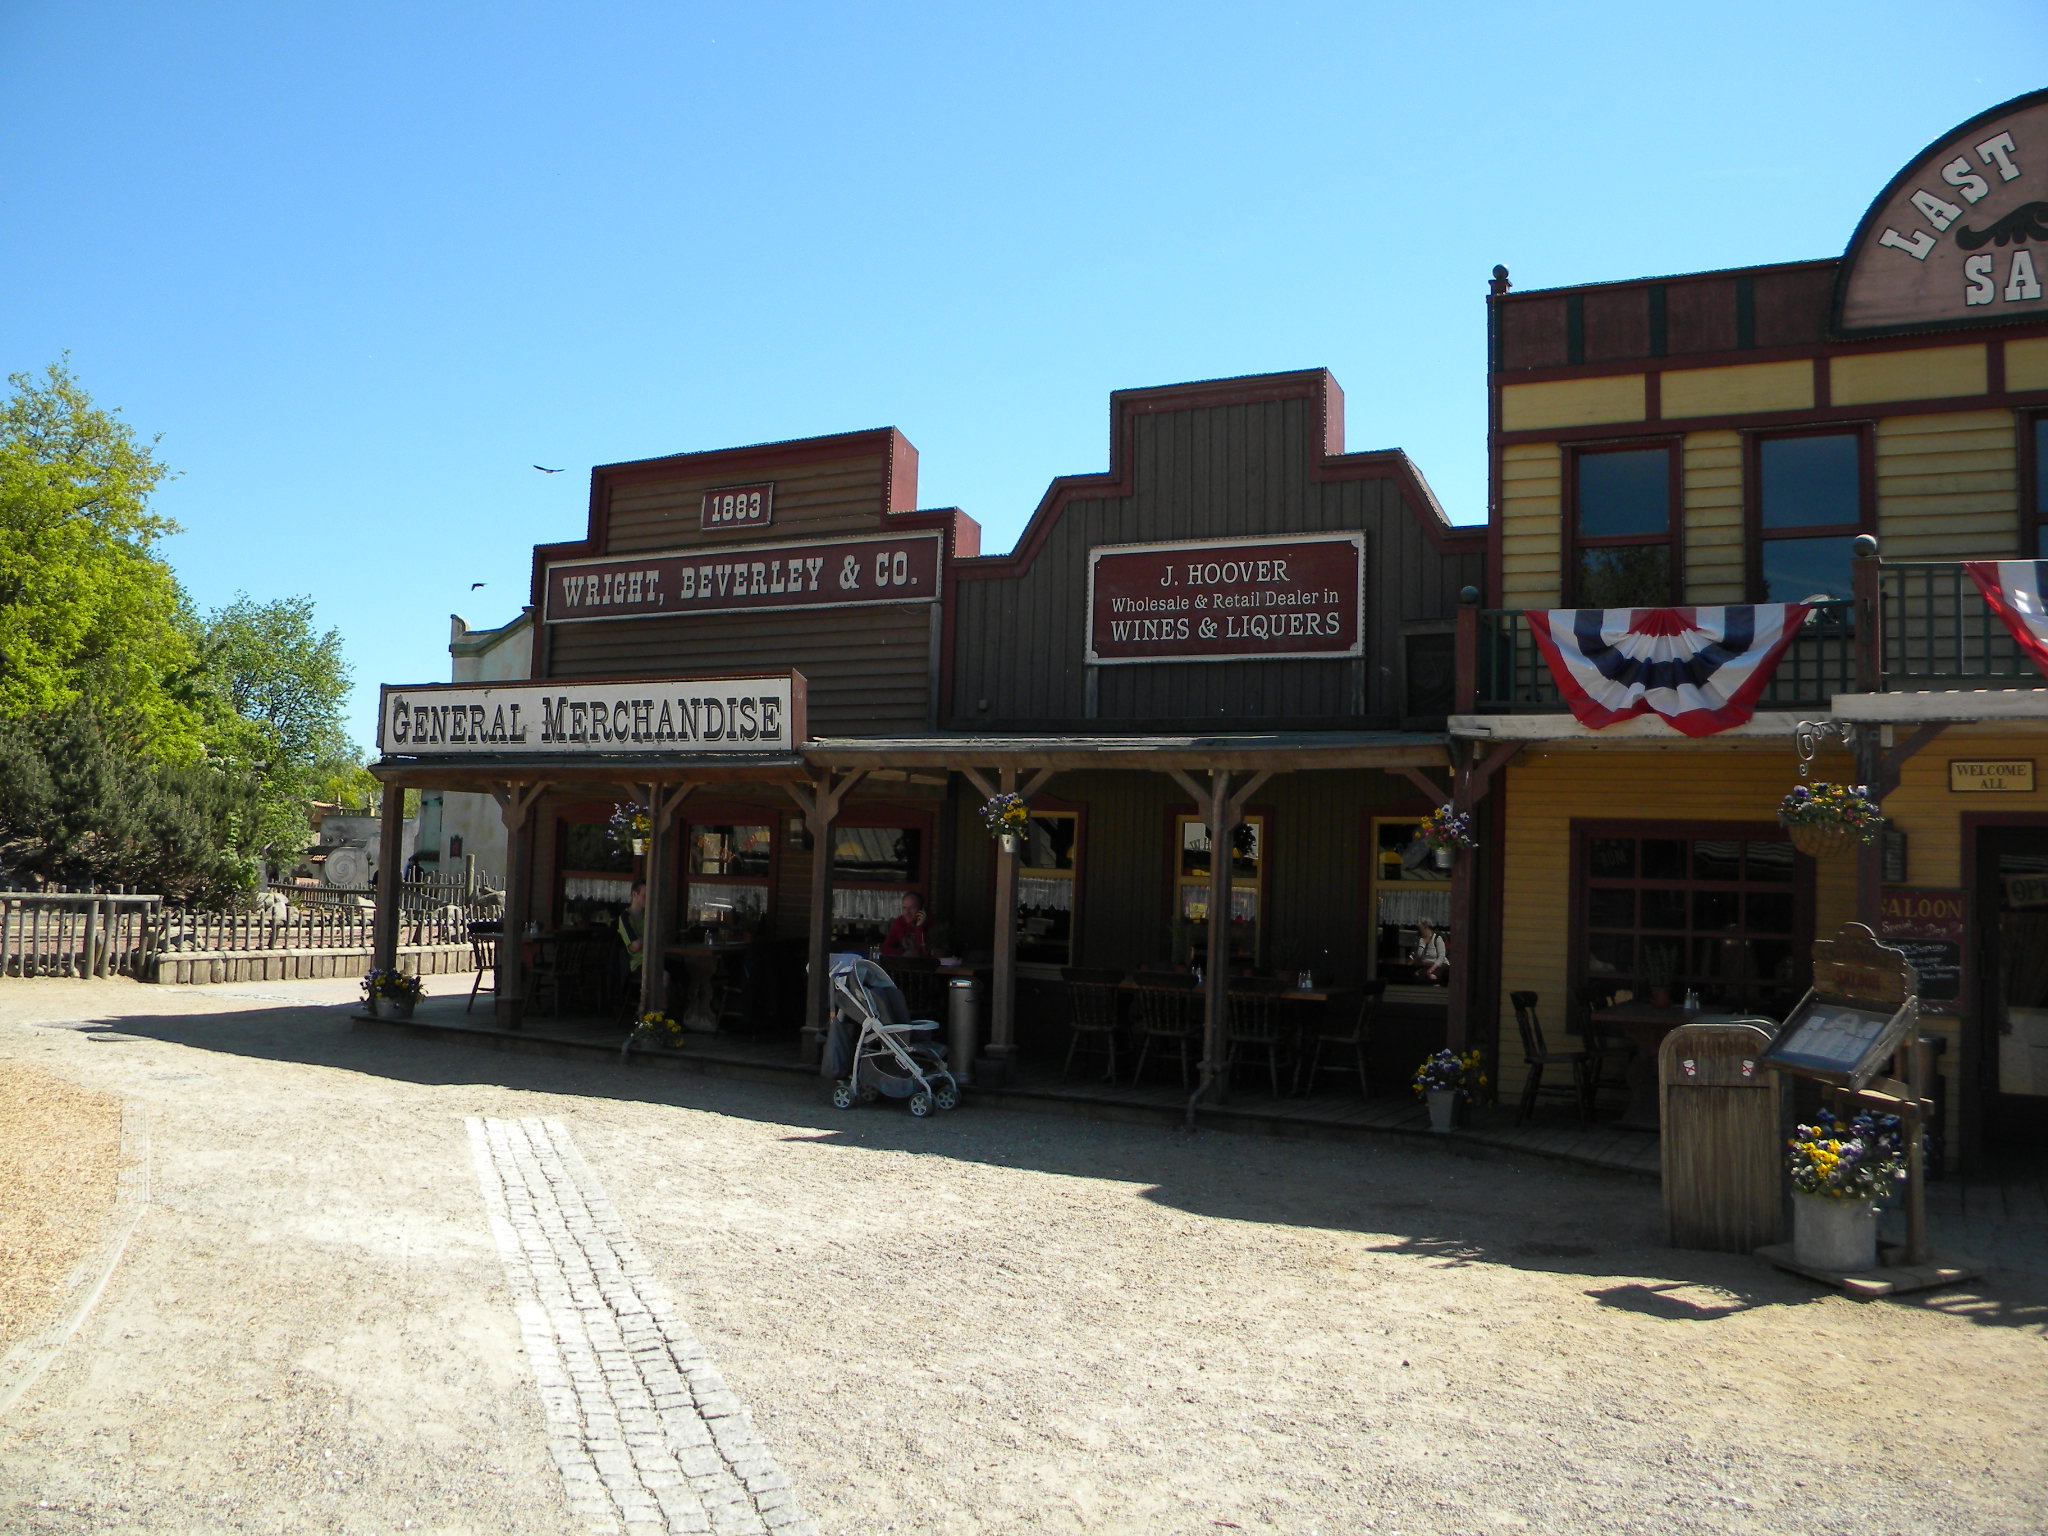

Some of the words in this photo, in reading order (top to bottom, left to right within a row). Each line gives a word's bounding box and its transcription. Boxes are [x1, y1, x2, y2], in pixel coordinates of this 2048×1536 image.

[1879, 130, 2022, 261] LAST
[711, 492, 762, 522] 1883
[562, 569, 665, 606] WRIGHT,
[680, 557, 824, 600] BEVERLEY
[838, 555, 861, 590] &
[875, 551, 918, 587] CO.
[1160, 565, 1179, 587] J.
[1187, 560, 1290, 586] HOOVER
[1111, 595, 1190, 613] Wholesale
[1194, 594, 1208, 610] &
[1212, 591, 1260, 609] Retail
[1265, 589, 1319, 607] Dealer
[1323, 588, 1339, 604] in
[1111, 617, 1190, 642] WINES
[1198, 617, 1219, 640] &
[1225, 612, 1341, 641] LIQUERS
[392, 698, 526, 745] GENERAL
[540, 696, 783, 744] MERCHANDISE
[1956, 764, 2027, 777] WELCOME
[1980, 778, 2007, 790] ALL
